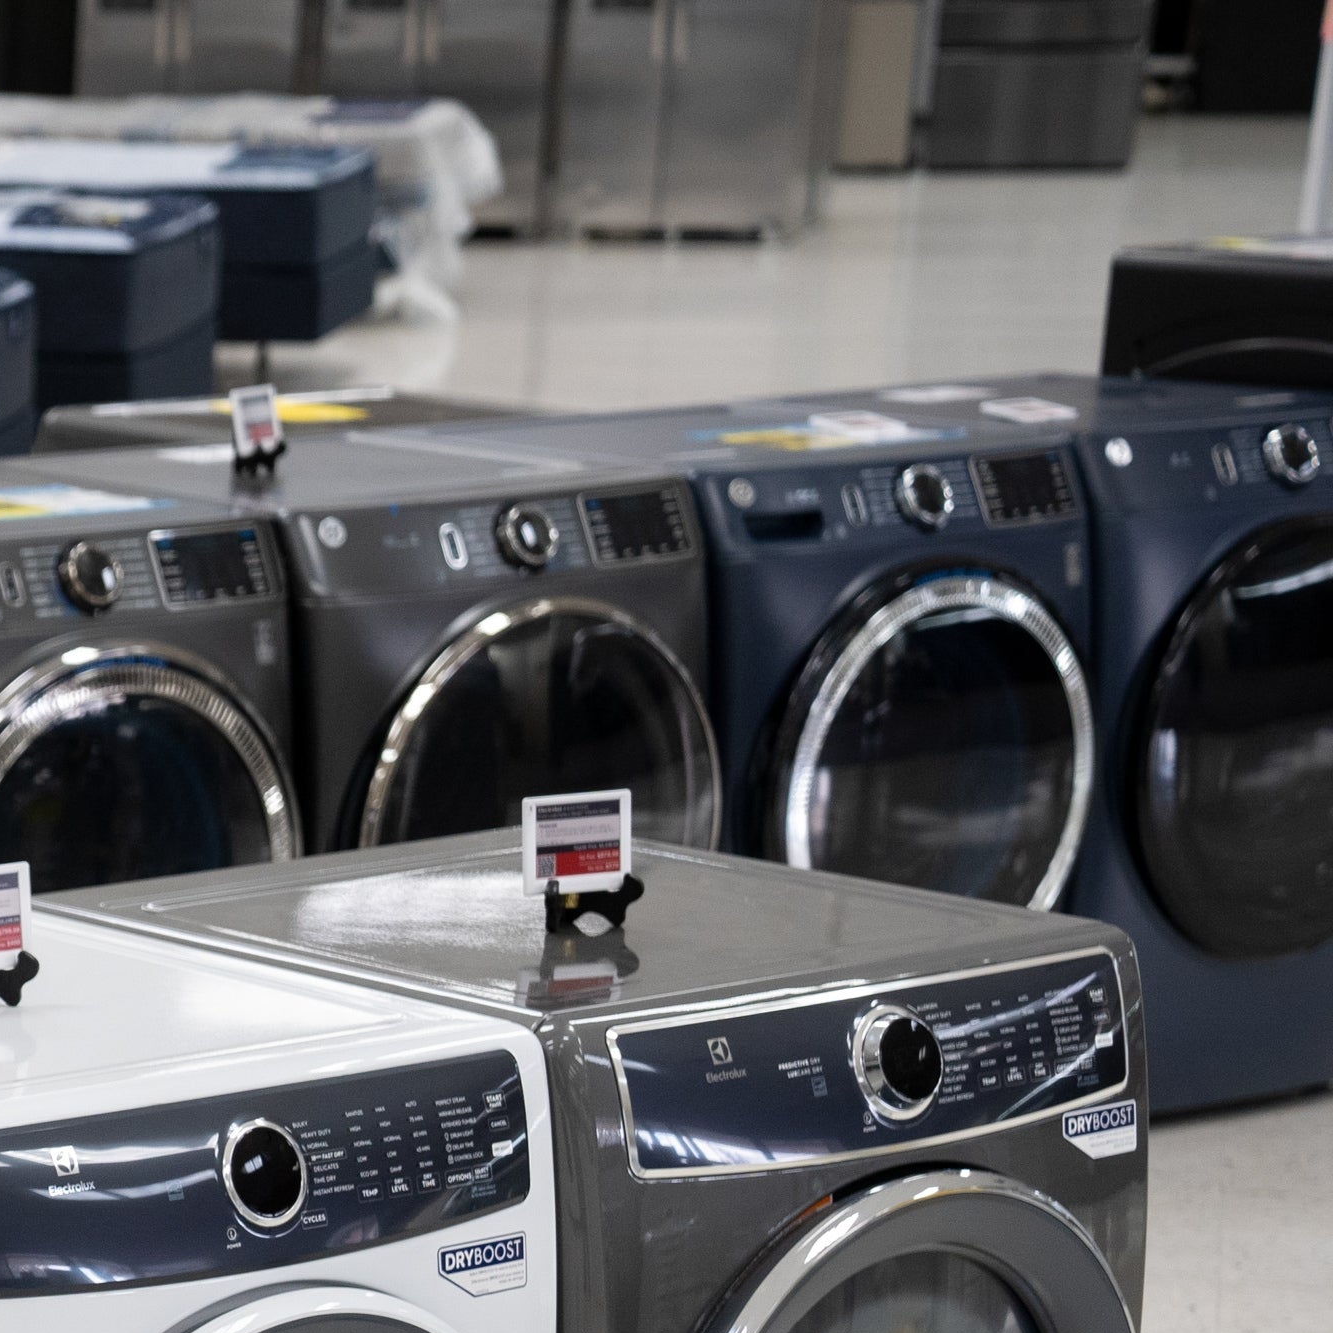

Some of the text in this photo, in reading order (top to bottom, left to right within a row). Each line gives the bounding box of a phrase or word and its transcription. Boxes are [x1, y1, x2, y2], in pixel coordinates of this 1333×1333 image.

[810, 1057, 821, 1065] DRY
[812, 1065, 823, 1074] DRY
[706, 1067, 747, 1084] Electrolux
[486, 1093, 502, 1102] START
[490, 1120, 507, 1128] CANCEL
[1068, 1105, 1132, 1135] DRYBOOST
[301, 1128, 331, 1139] HEAVY DUTY
[334, 1150, 344, 1158] DRY
[314, 1163, 339, 1172] DELICATES
[447, 1172, 472, 1183] OPTIONS
[391, 1184, 409, 1193] LEVEL
[422, 1179, 435, 1188] TIME
[48, 1181, 95, 1197] Electrolux
[313, 1184, 354, 1196] INSTANT REFRESH
[362, 1188, 378, 1198] TEMP
[303, 1213, 326, 1224] CYCLES
[445, 1239, 521, 1271] DRYBOOST
